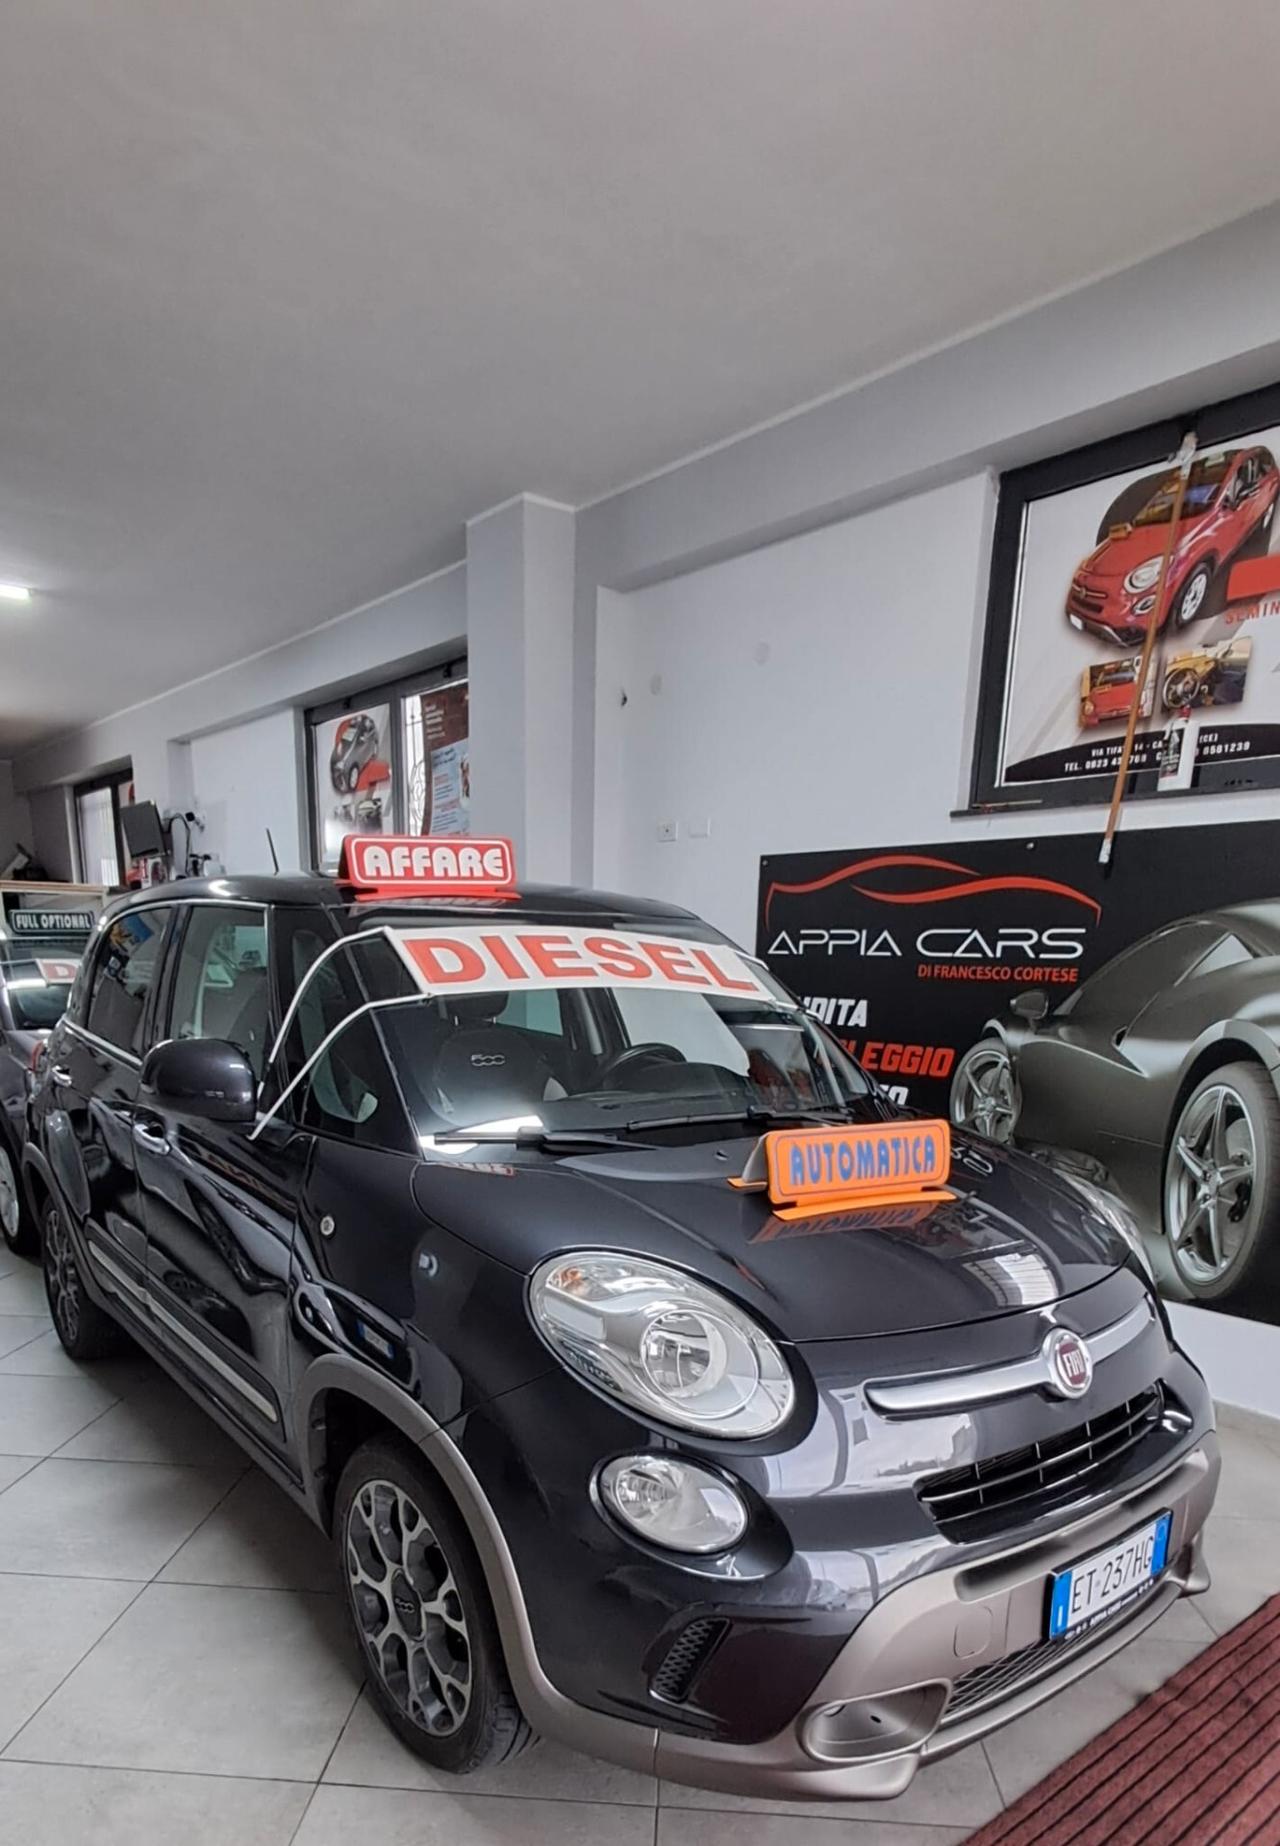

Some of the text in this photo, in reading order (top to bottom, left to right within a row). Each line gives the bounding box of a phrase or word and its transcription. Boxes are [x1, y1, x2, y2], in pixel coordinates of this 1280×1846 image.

[362, 845, 505, 878] AFFARE
[16, 914, 91, 929] FULL OPTIONAL
[767, 928, 1087, 959] APPIA CARS
[402, 934, 760, 993] DIESEL
[917, 963, 1080, 983] DI FRANCESCO CORTESE
[789, 1135, 937, 1186] AUTOMATICA
[1062, 1349, 1086, 1378] FIAT
